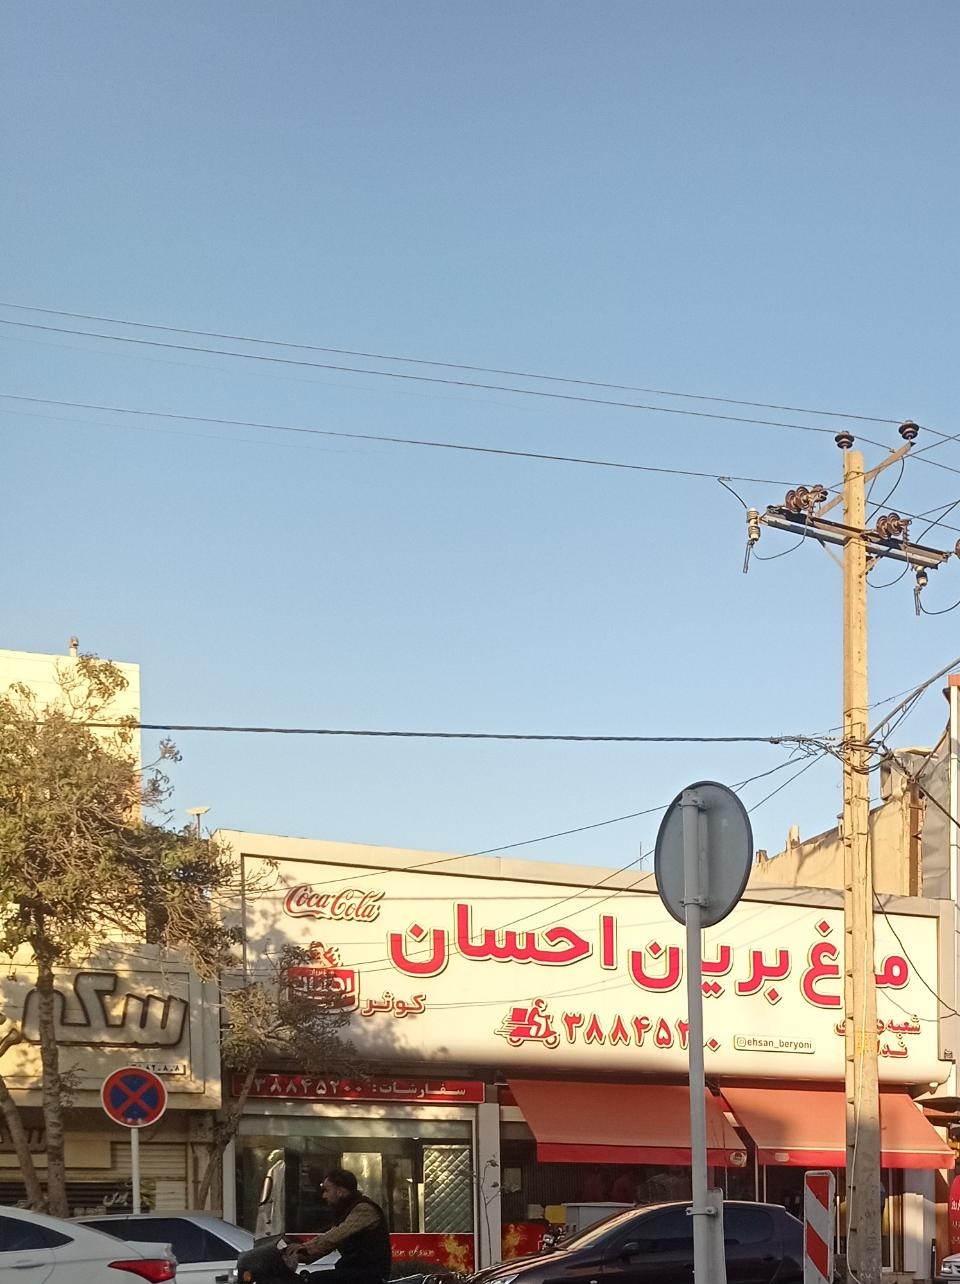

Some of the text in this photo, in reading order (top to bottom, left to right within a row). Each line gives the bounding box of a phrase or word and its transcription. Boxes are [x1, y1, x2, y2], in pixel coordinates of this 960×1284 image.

[284, 885, 385, 920] Coca-Cola
[389, 903, 909, 1006] مغ برین احسان
[362, 990, 426, 1017] کوثر
[563, 1012, 719, 1049] ۳۸۸۴۵۲۰
[887, 1014, 922, 1037] شعبه
[746, 1038, 813, 1050] ehsan_beryoni
[254, 1078, 363, 1095] ۳۸۸۴۵۲۰۰
